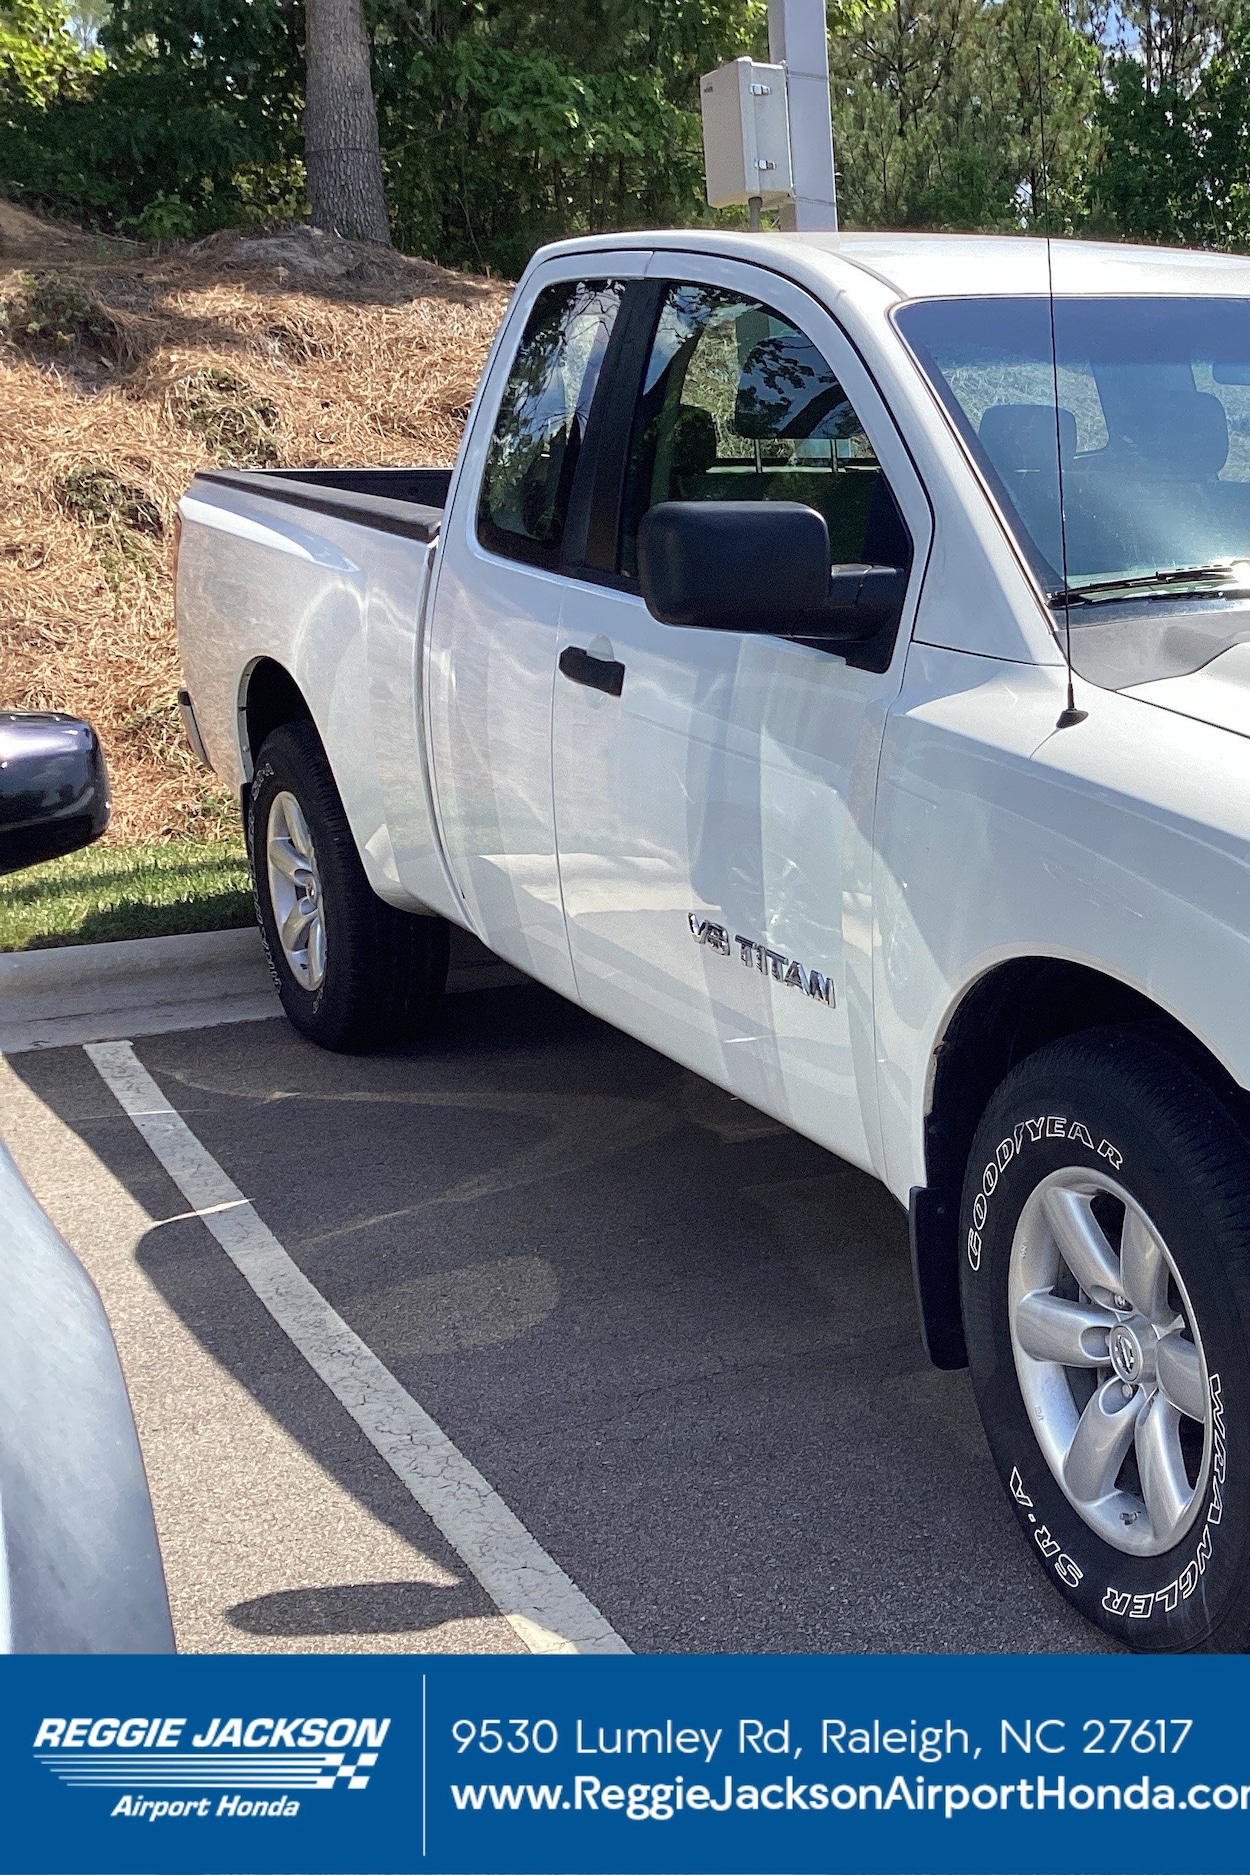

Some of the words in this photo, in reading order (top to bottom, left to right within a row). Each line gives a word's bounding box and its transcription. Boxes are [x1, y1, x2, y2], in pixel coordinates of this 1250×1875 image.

[687, 912, 731, 956] V8
[735, 934, 837, 1009] TITAN
[1101, 1373, 1227, 1619] WRANGLER
